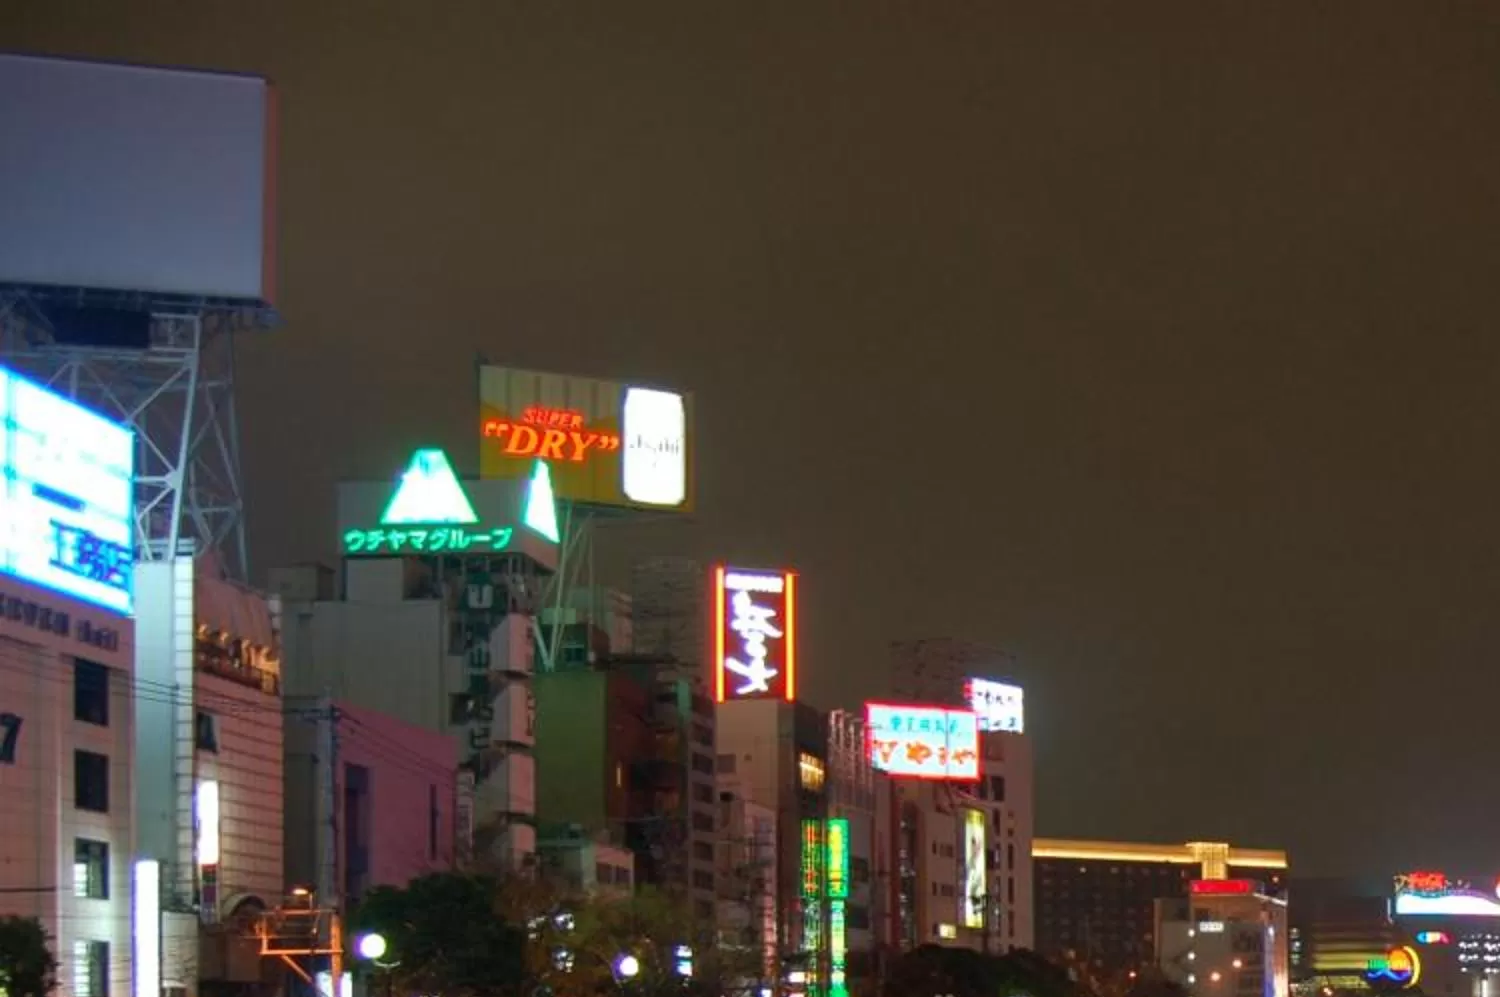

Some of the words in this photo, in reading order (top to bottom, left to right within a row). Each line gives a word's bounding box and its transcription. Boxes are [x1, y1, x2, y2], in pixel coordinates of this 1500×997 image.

[523, 407, 584, 428] SUPER
[343, 526, 514, 552] ウチヤマグループ
